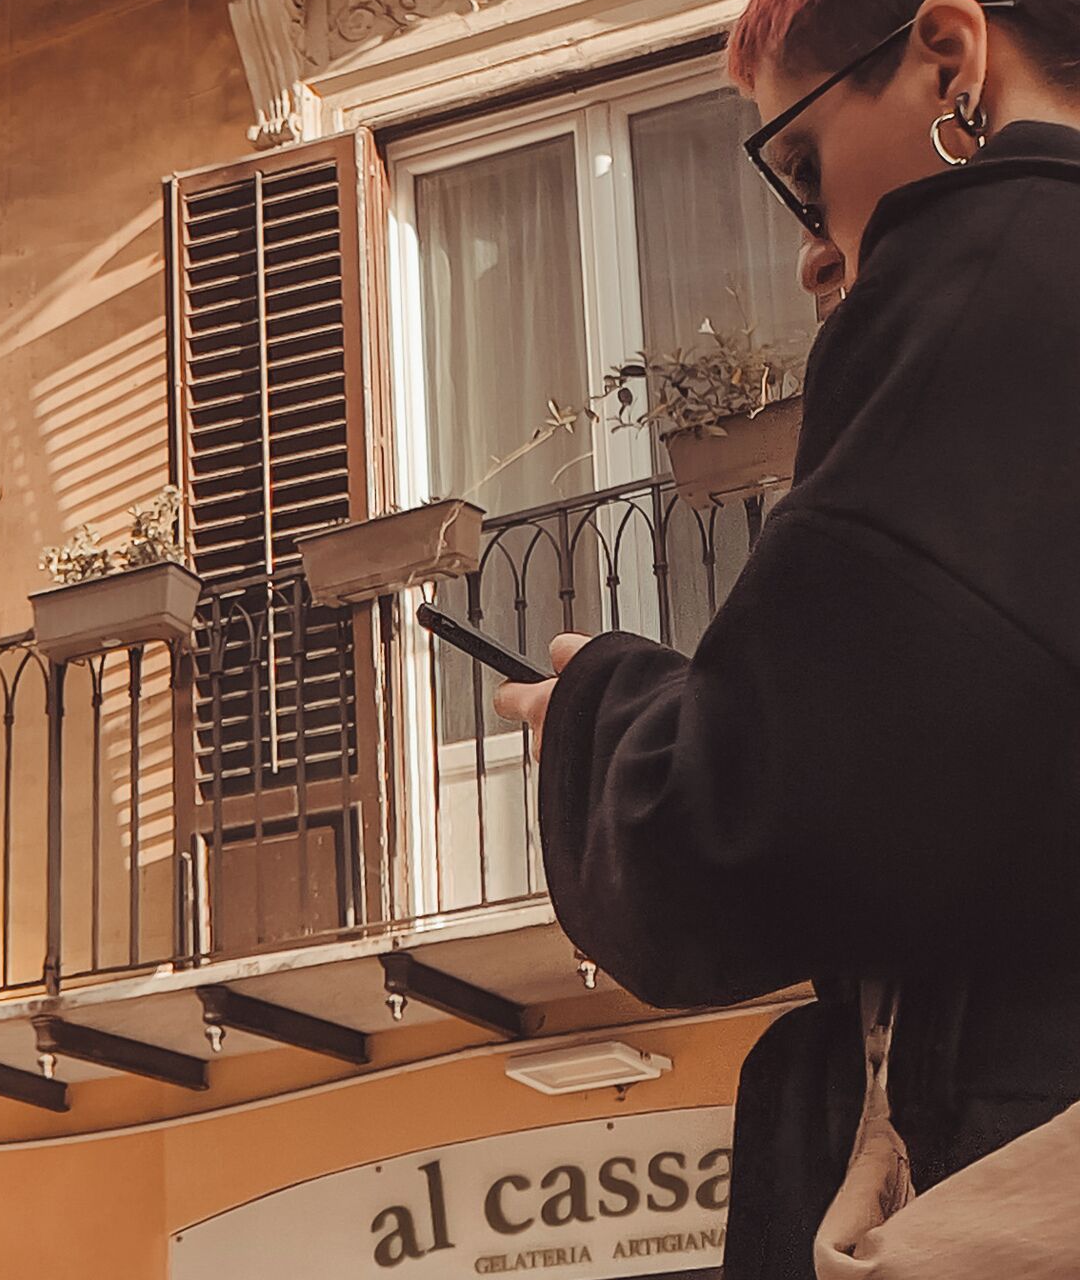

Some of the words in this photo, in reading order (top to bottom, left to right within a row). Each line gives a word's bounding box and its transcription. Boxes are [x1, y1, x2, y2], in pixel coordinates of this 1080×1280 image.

[371, 1160, 455, 1268] al
[485, 1148, 731, 1234] cassa
[474, 1246, 592, 1274] GELATERIA
